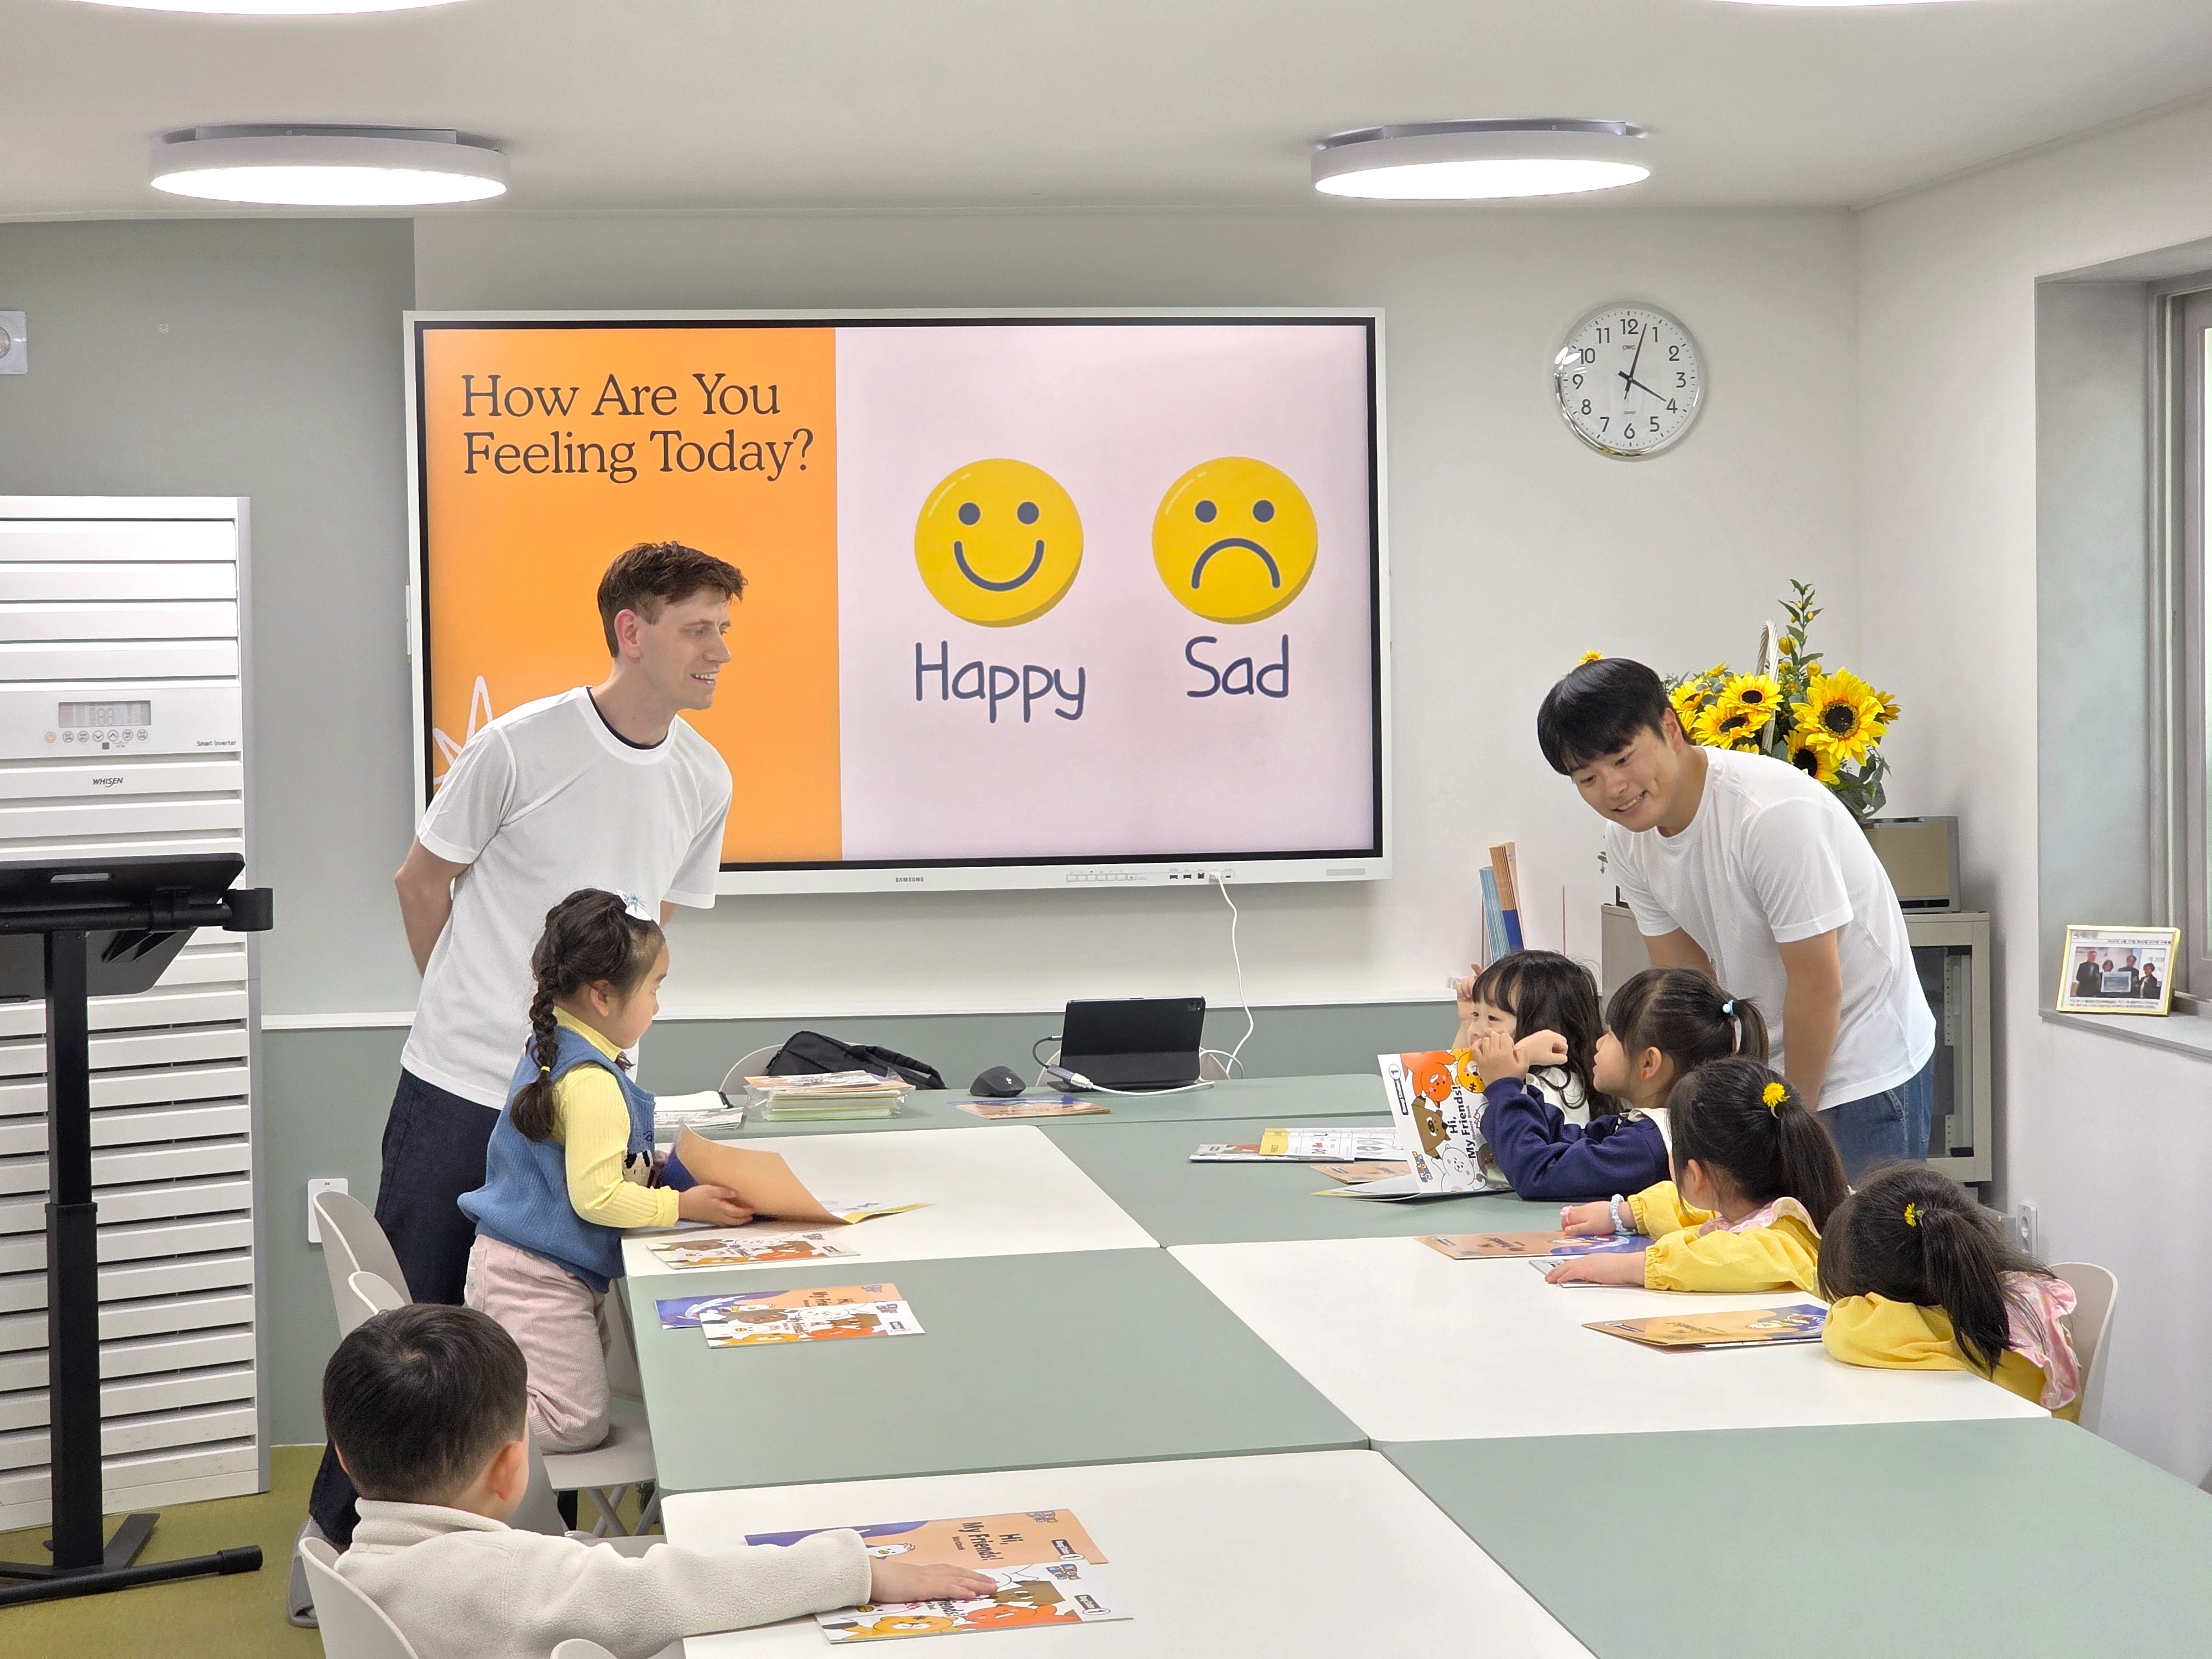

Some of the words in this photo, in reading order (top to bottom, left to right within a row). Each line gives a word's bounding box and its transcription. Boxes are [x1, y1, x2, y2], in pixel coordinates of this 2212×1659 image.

[1596, 327, 1610, 344] 11
[1620, 319, 1639, 335] 12
[1652, 326, 1658, 343] 1
[1578, 347, 1595, 364] 10
[1668, 345, 1680, 361] 2
[1572, 373, 1584, 390] 9
[1676, 372, 1687, 388] 3
[461, 374, 580, 417] How
[591, 373, 677, 416] Are
[692, 373, 781, 415] You
[1581, 399, 1592, 415] 8
[1666, 398, 1678, 414] 4
[1599, 416, 1610, 432] 7
[1624, 422, 1635, 440] 6
[1650, 416, 1660, 432] 5
[463, 430, 638, 484] Feeling
[649, 427, 814, 482] Today?
[1185, 634, 1290, 698] Sad
[915, 640, 1086, 724] Happy
[92, 777, 123, 787] WHISEN
[1452, 1085, 1470, 1136] Friends!
[1447, 1117, 1458, 1134] Hi,
[1465, 1139, 1477, 1159] My
[958, 1522, 985, 1532] My
[968, 1533, 1004, 1561] Friends!
[999, 1533, 1024, 1545] Hi,
